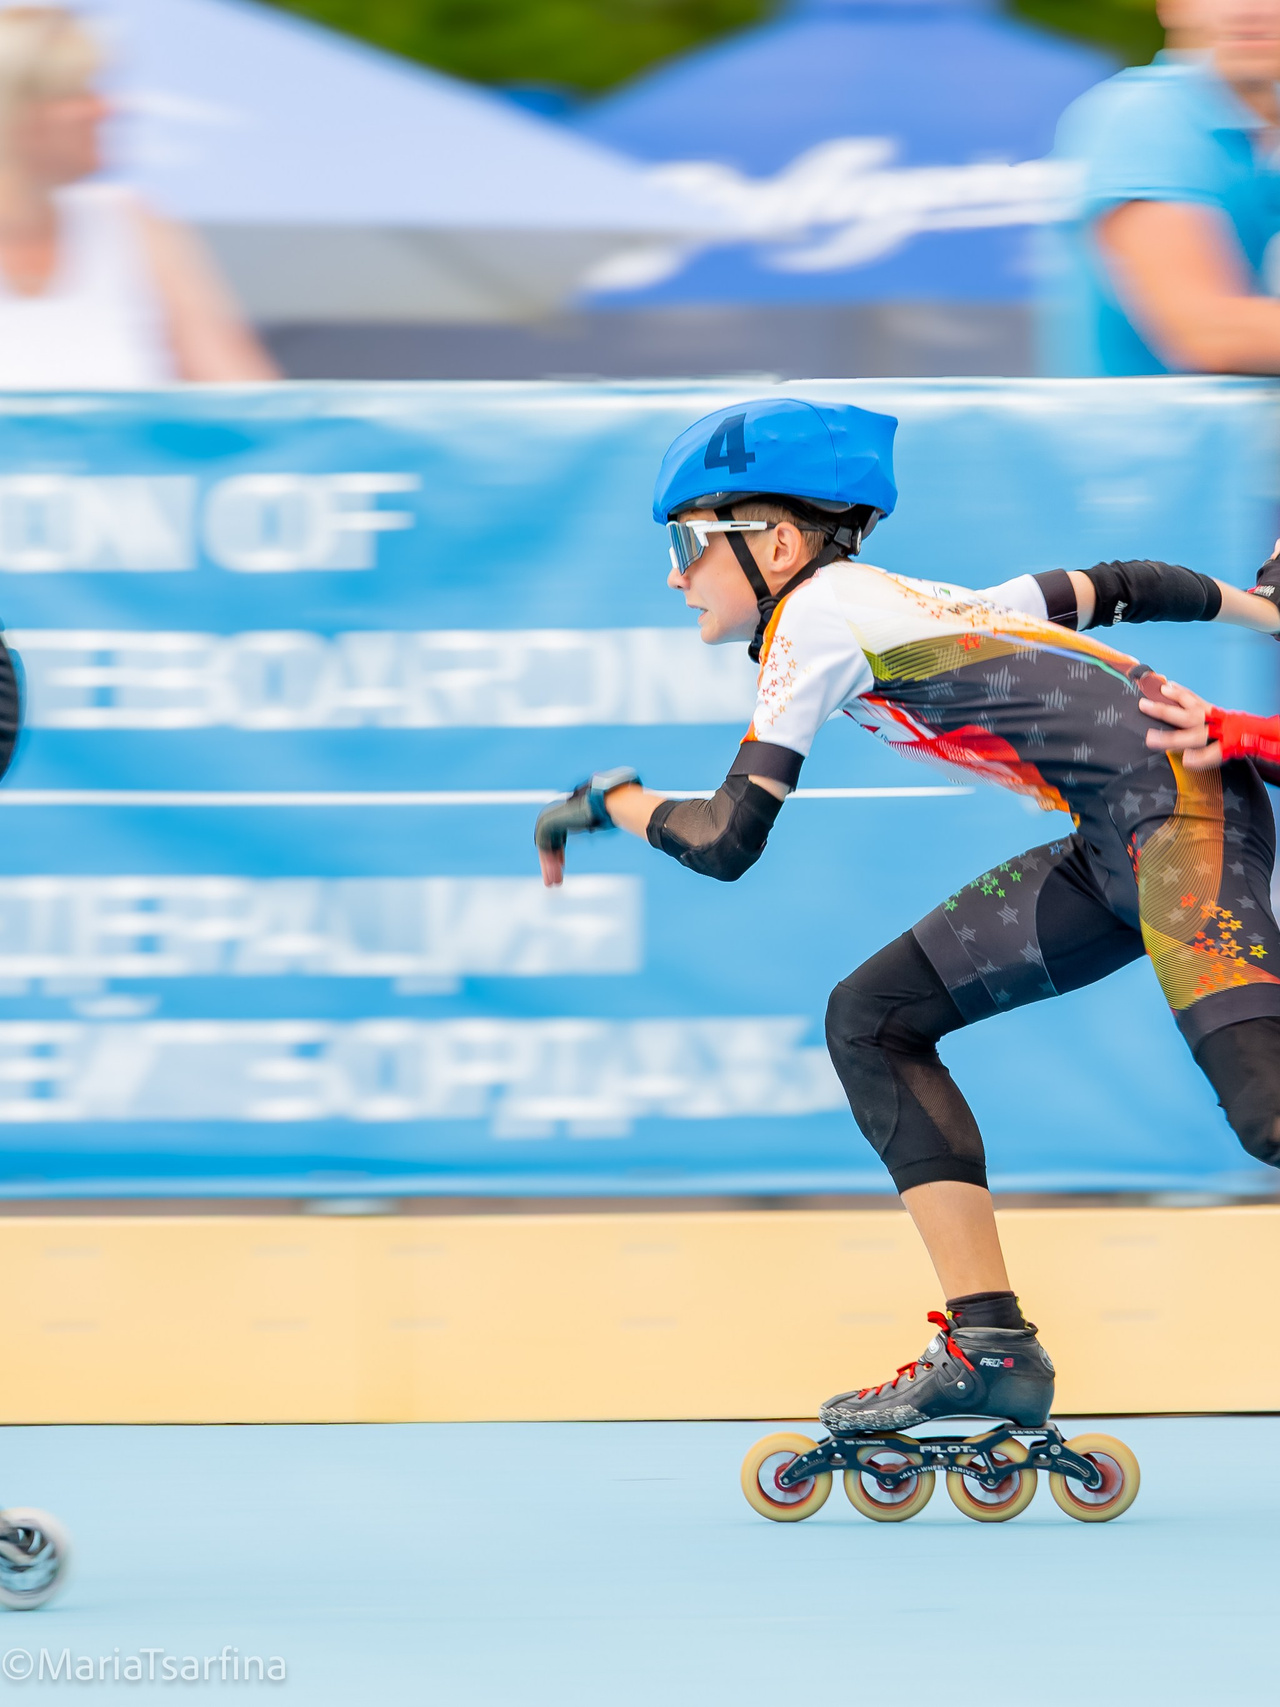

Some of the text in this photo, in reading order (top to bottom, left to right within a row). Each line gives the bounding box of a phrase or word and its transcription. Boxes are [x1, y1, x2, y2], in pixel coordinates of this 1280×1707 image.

[704, 412, 756, 475] 4
[202, 471, 420, 573] OF
[952, 1466, 976, 1477] DRIVE
